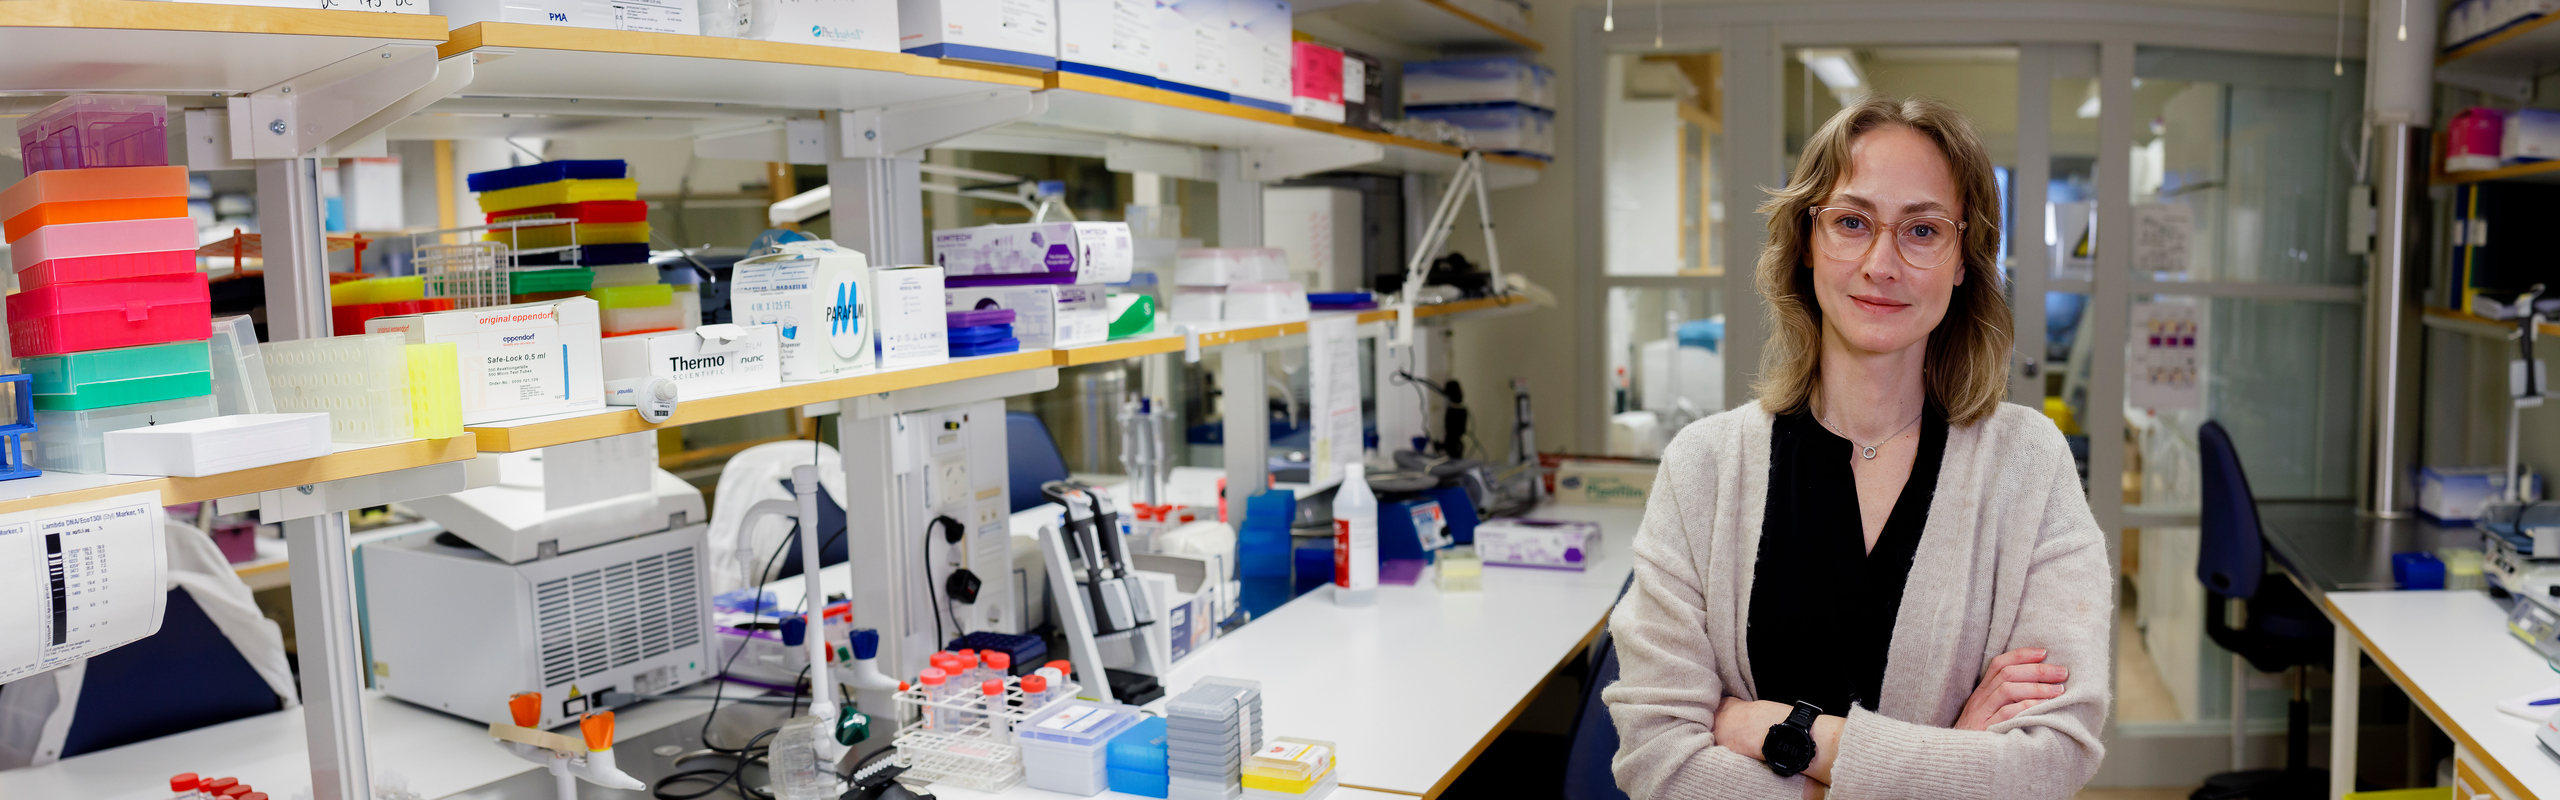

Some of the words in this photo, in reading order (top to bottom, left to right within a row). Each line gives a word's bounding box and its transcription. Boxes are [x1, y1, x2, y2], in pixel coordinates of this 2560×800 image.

[549, 12, 568, 22] PMA
[751, 304, 755, 312] 4
[772, 301, 783, 310] 125
[479, 314, 511, 325] original
[512, 311, 554, 323] eppendorf
[826, 304, 864, 322] PARAFILM
[503, 333, 535, 343] eppendorf
[745, 341, 763, 350] FILM
[487, 354, 523, 364] Safe-Lock
[669, 355, 725, 372] Thermo
[740, 355, 764, 364] nunc
[672, 368, 725, 381] SCIENTIFIC
[42, 520, 65, 530] Lambda
[115, 509, 137, 518] Marker,
[137, 508, 145, 516] 16
[1777, 741, 1799, 757] 11:07
